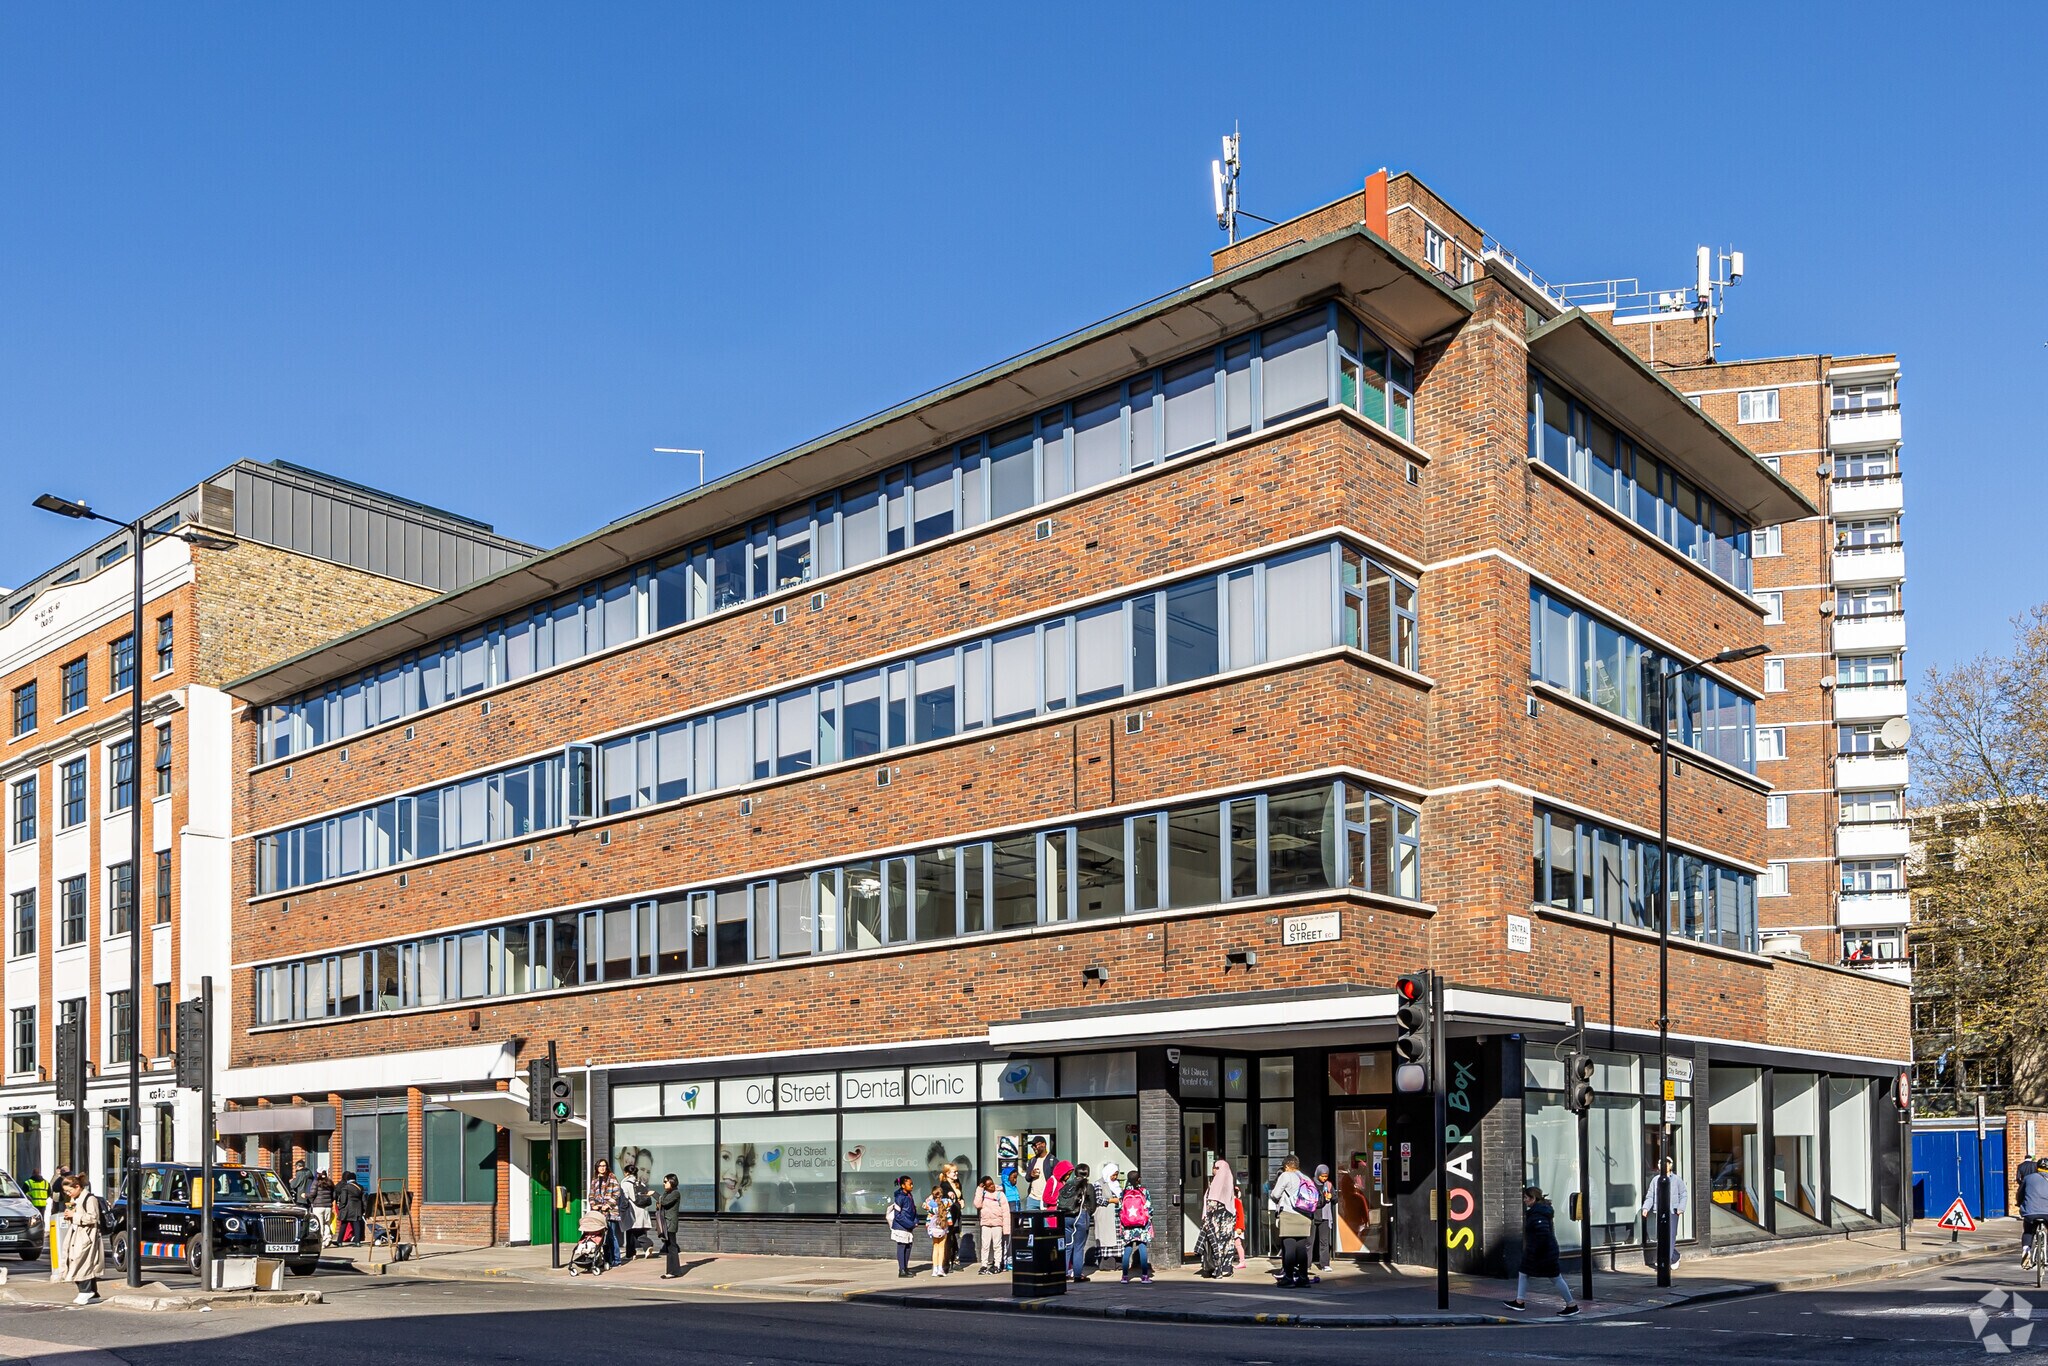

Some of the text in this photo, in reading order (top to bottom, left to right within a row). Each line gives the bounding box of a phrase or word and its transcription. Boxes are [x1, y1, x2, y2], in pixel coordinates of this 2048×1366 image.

[1289, 922, 1307, 932] OLD
[1290, 930, 1322, 942] STREET
[1511, 935, 1528, 946] STREET
[746, 1073, 964, 1104] Old Street Dental Clinic
[788, 1146, 827, 1156] Old Street
[788, 1157, 836, 1168] Dental Clinic
[870, 1157, 919, 1168] Dental Clinic
[1445, 1124, 1475, 1251] SOAP
[158, 1223, 183, 1232] SHERBET
